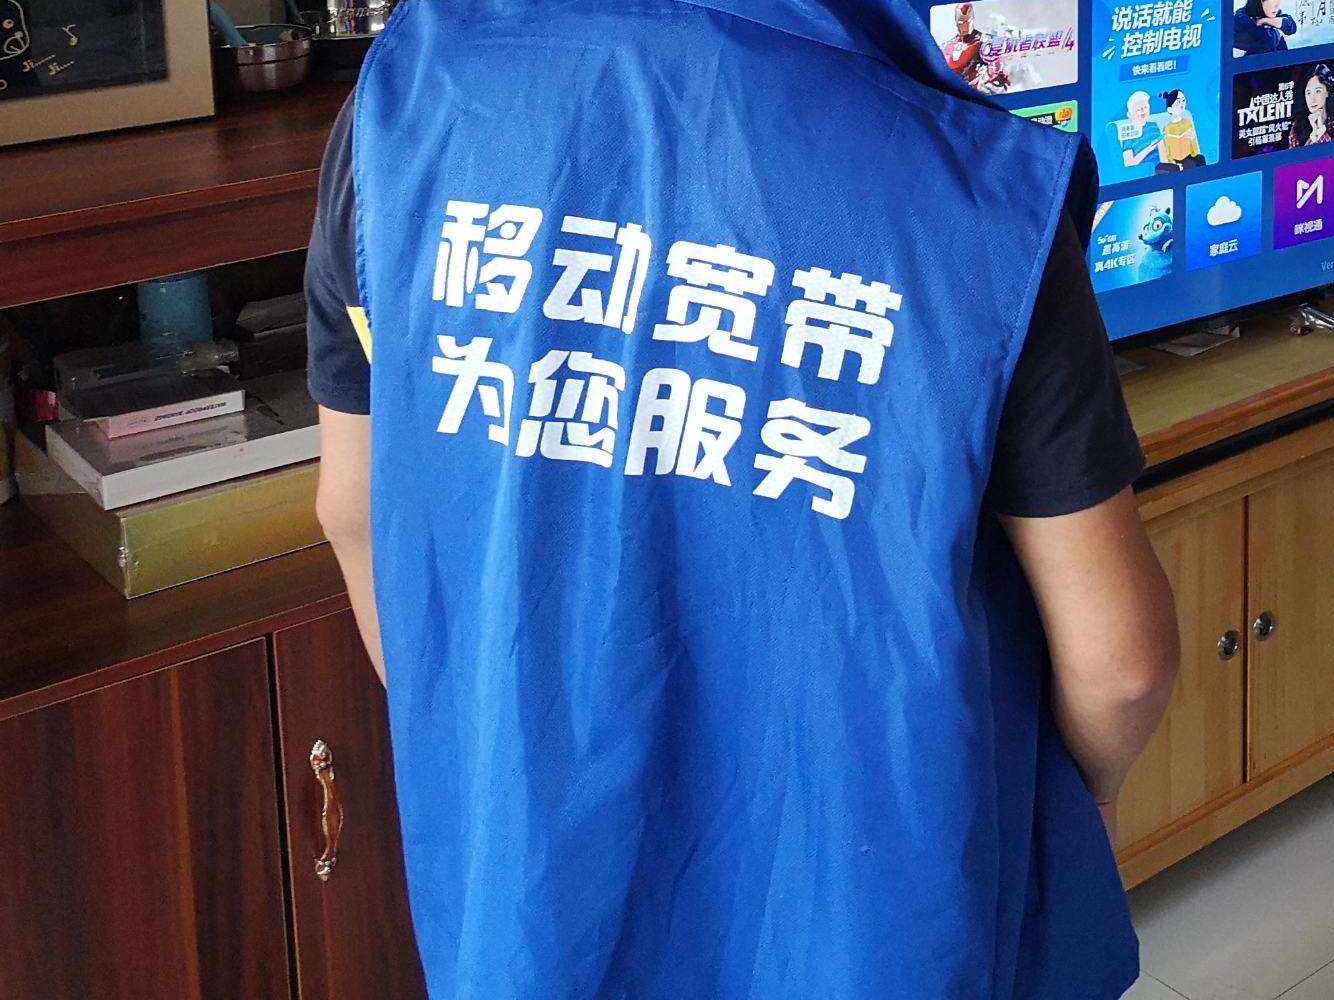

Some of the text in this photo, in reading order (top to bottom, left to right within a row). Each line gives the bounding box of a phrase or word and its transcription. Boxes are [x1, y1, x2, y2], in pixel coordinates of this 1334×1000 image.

[1120, 23, 1203, 59] 控制电视
[1237, 98, 1294, 127] TALENT
[1209, 238, 1239, 257] 家庭云
[432, 199, 903, 385] 移动宽带
[432, 335, 872, 520] 为您服务
